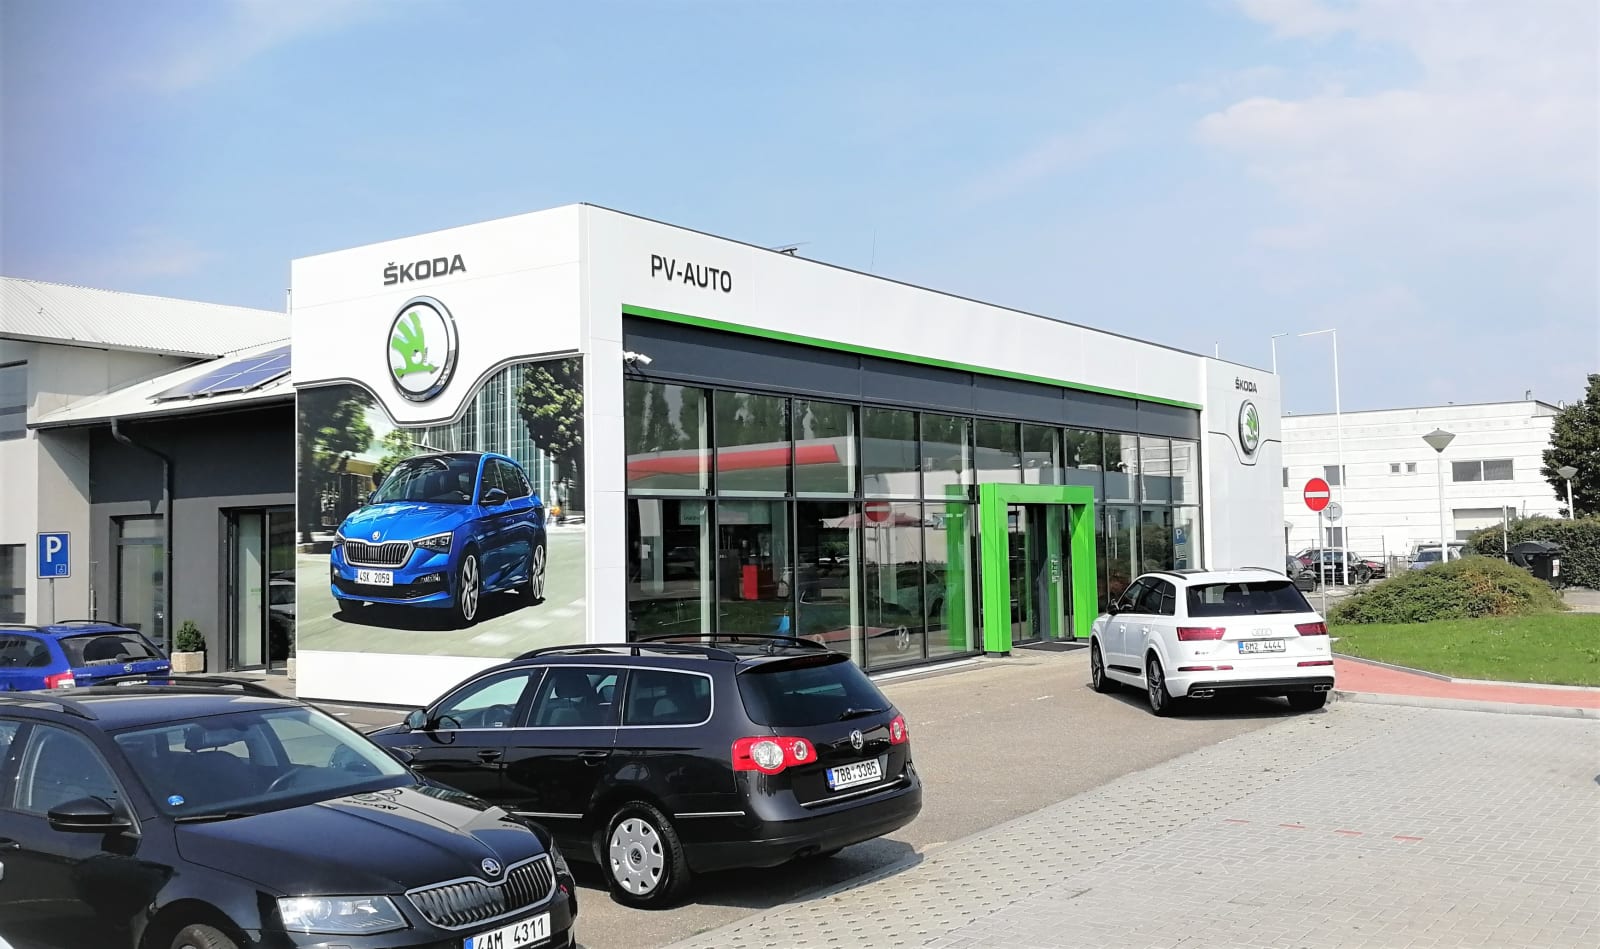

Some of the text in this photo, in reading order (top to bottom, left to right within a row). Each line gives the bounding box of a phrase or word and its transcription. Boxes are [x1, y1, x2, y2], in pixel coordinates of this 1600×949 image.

[383, 254, 467, 286] ŠKODA
[651, 254, 732, 293] PV-AUTO
[1235, 376, 1257, 394] ŠKODA
[46, 536, 62, 563] P
[514, 917, 544, 944] 4311
